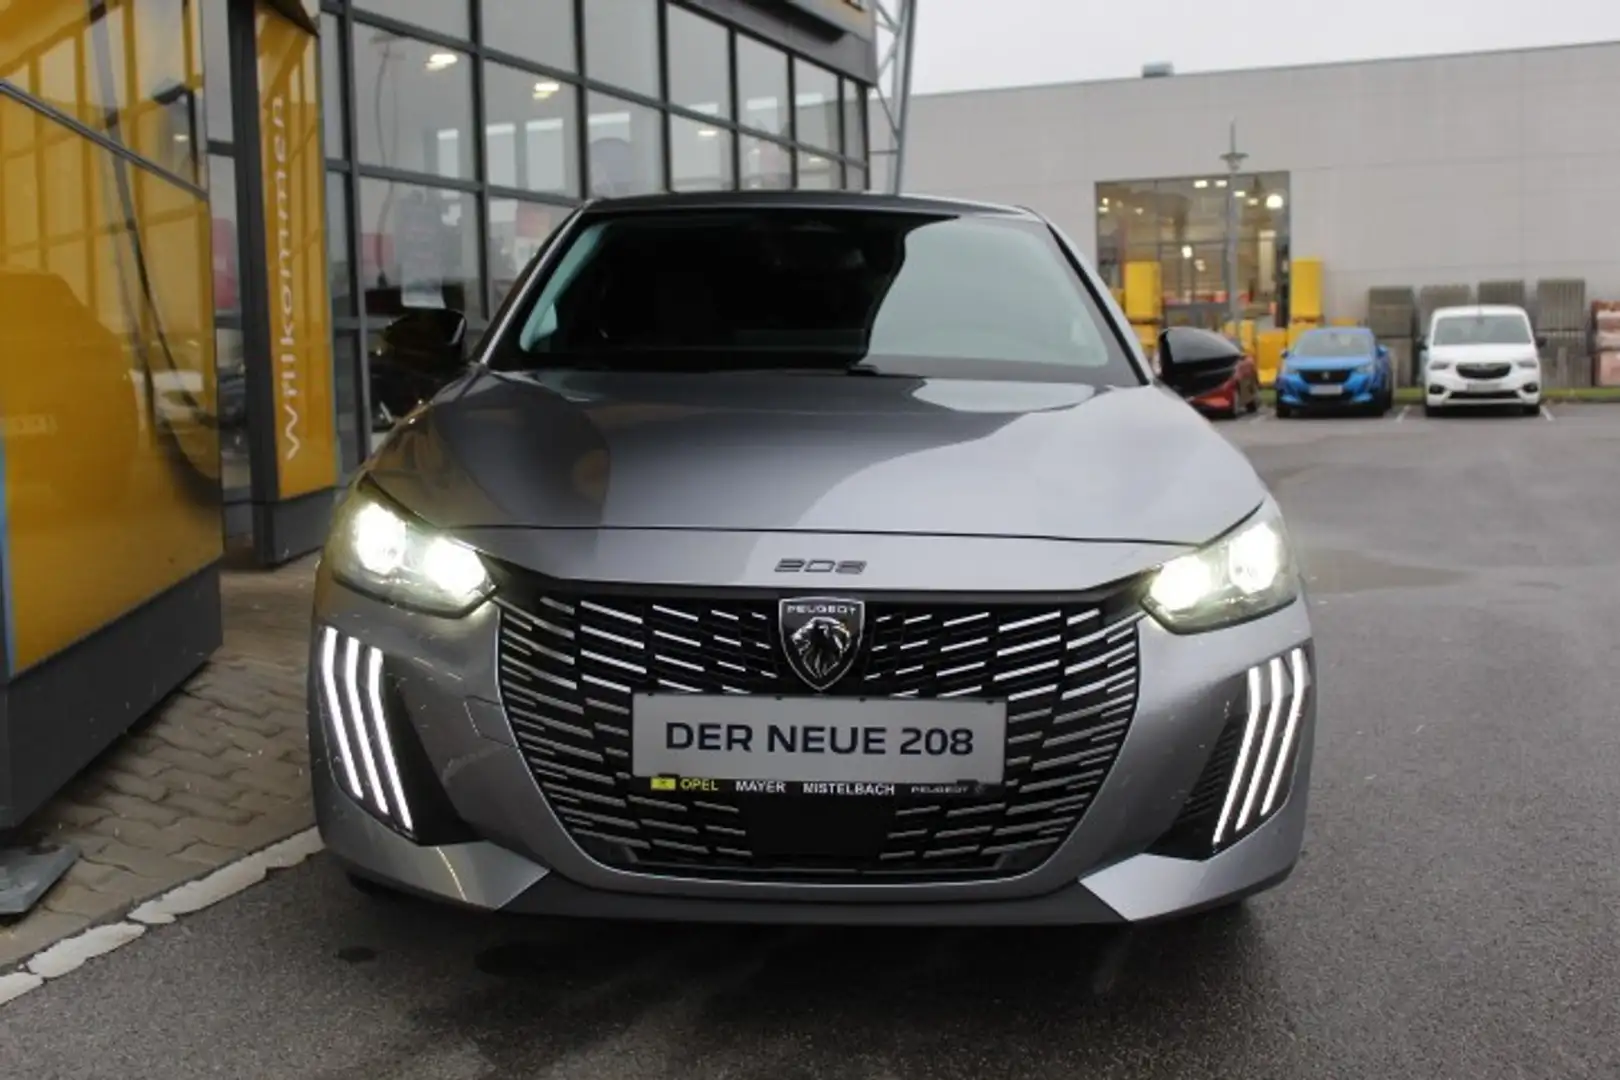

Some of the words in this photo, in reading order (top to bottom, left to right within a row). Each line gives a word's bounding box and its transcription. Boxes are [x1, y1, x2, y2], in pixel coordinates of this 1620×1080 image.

[271, 95, 301, 461] Willkommen
[774, 558, 867, 575] 208
[786, 604, 857, 616] PEUGEOT
[665, 721, 753, 752] DER
[766, 724, 887, 756] NEUE
[899, 727, 974, 757] 208
[680, 778, 719, 793] OPEL
[735, 780, 786, 795] MAYER
[803, 782, 895, 796] MISTELBACH
